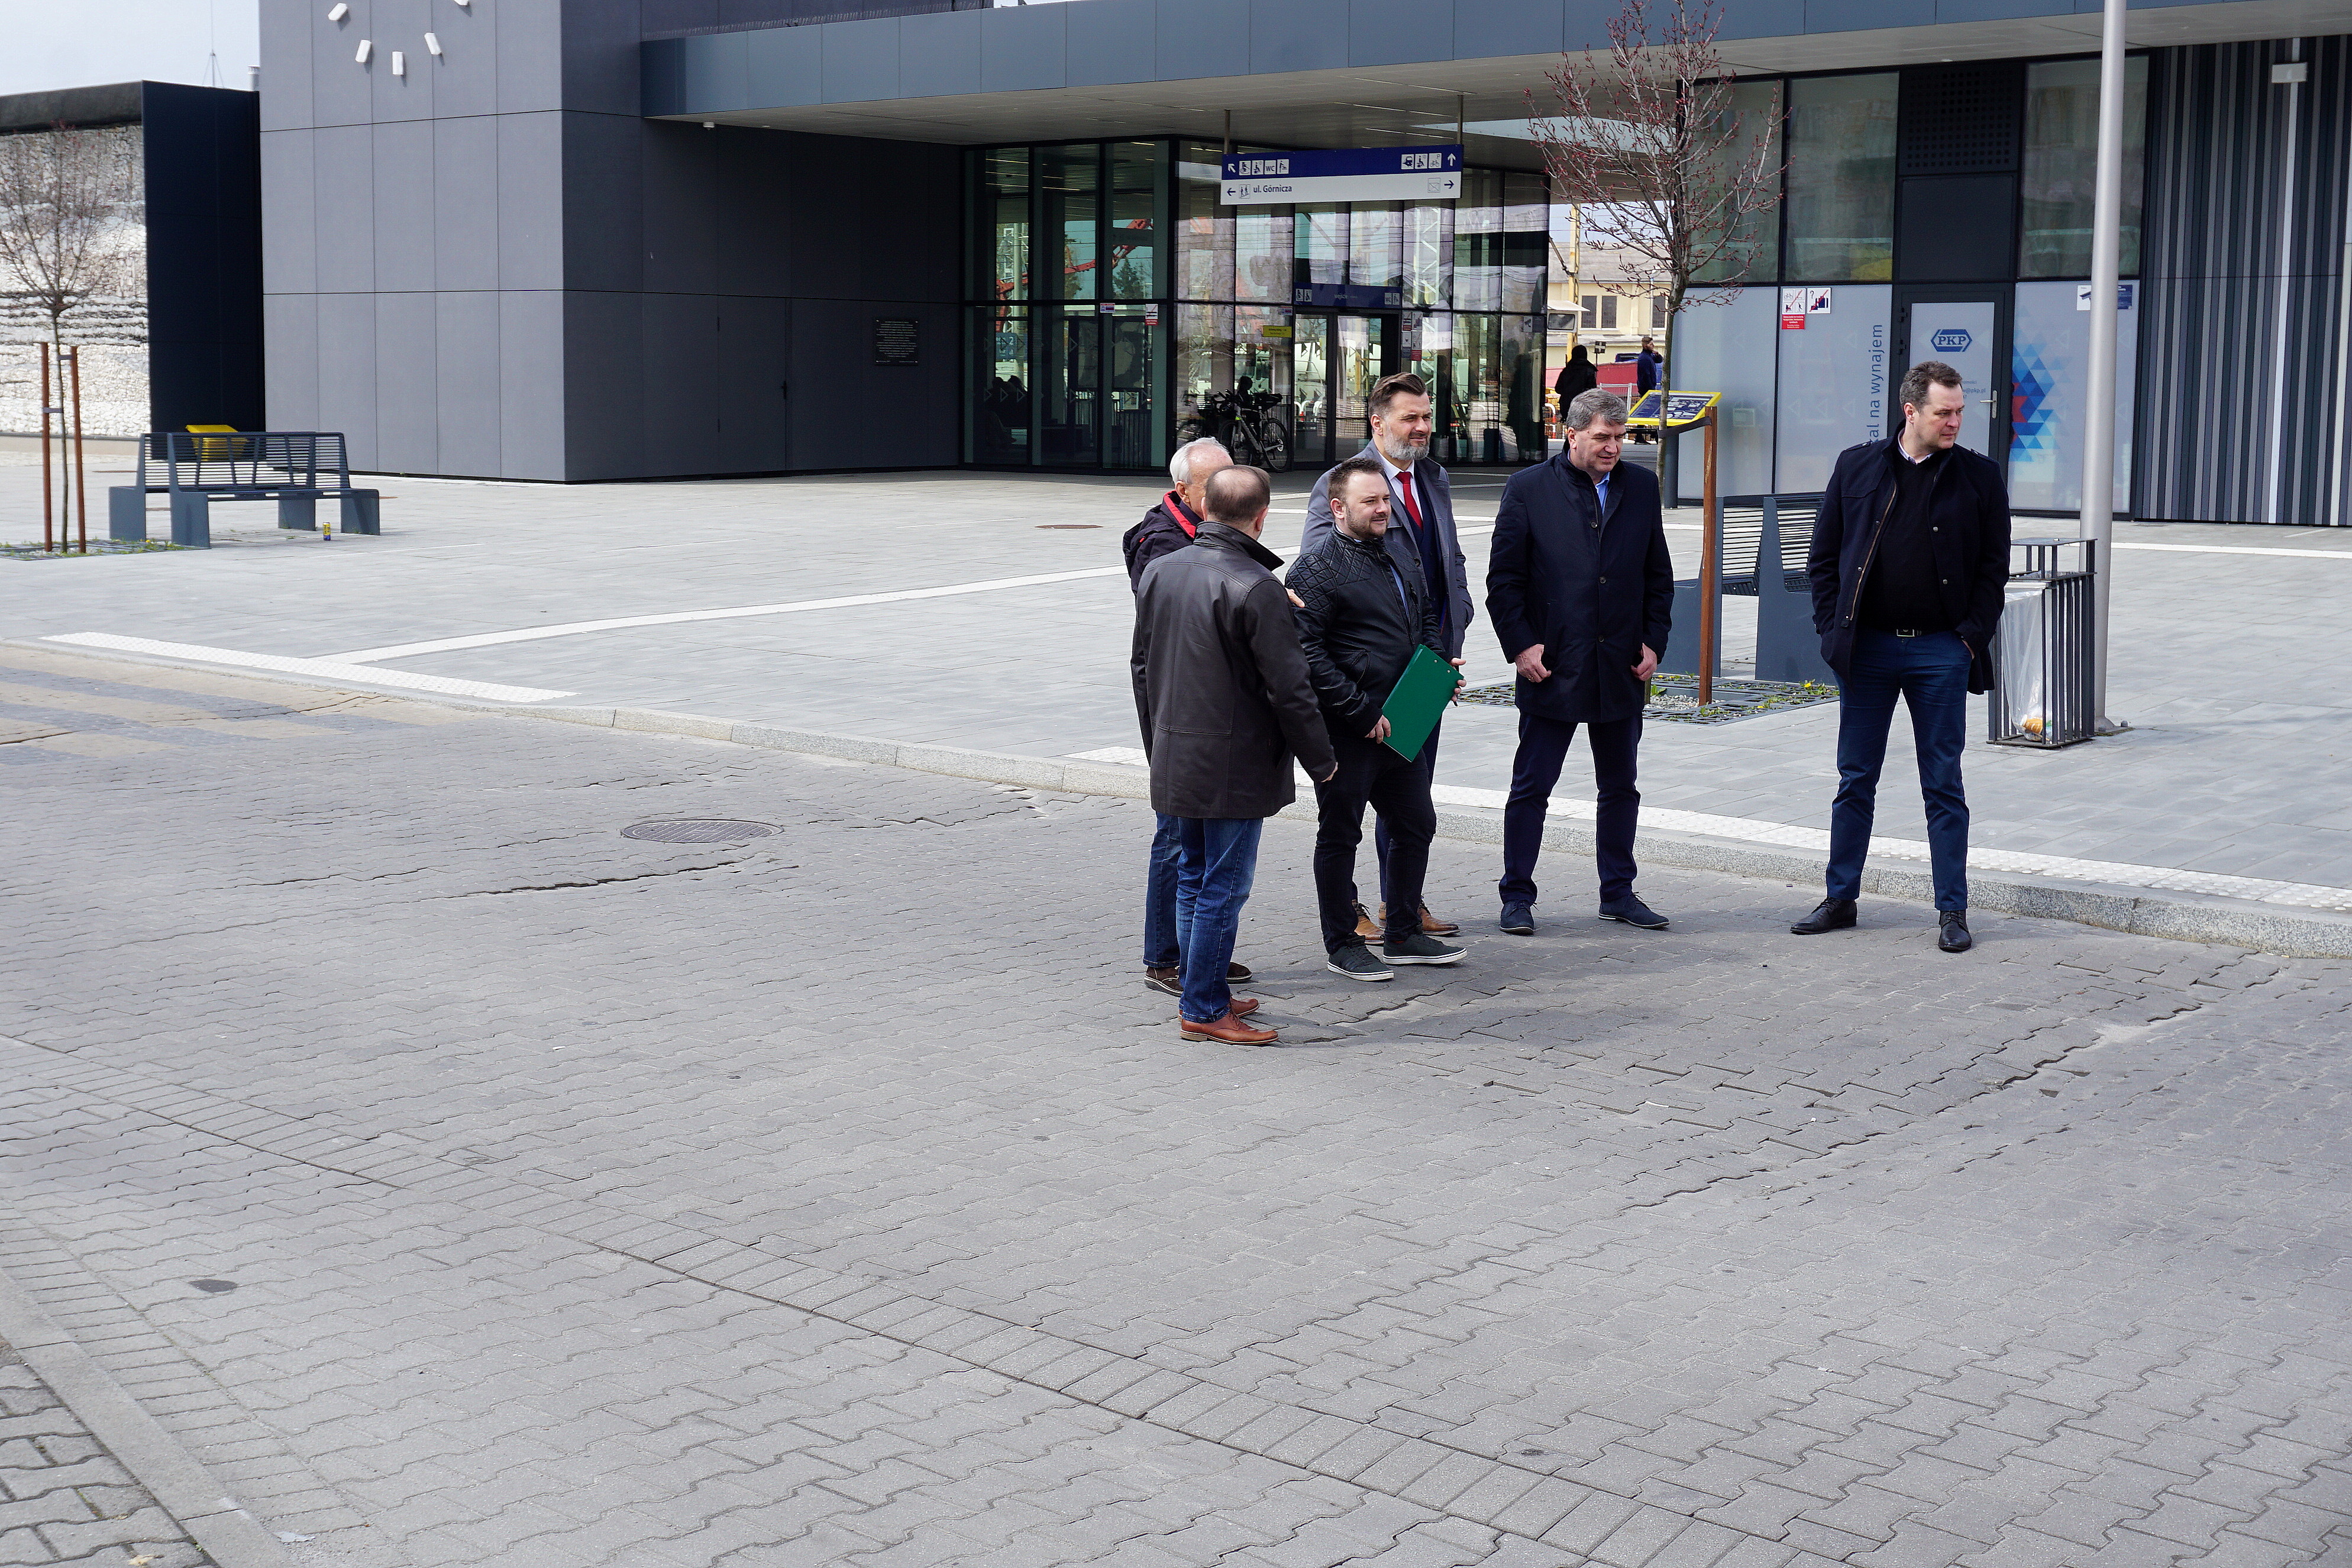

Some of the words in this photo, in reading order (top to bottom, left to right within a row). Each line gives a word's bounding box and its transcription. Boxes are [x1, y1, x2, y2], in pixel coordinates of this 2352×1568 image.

[1263, 184, 1292, 193] Górnicza
[1937, 336, 1966, 345] PKP
[1868, 325, 1885, 394] wynajem
[1870, 400, 1879, 418] na
